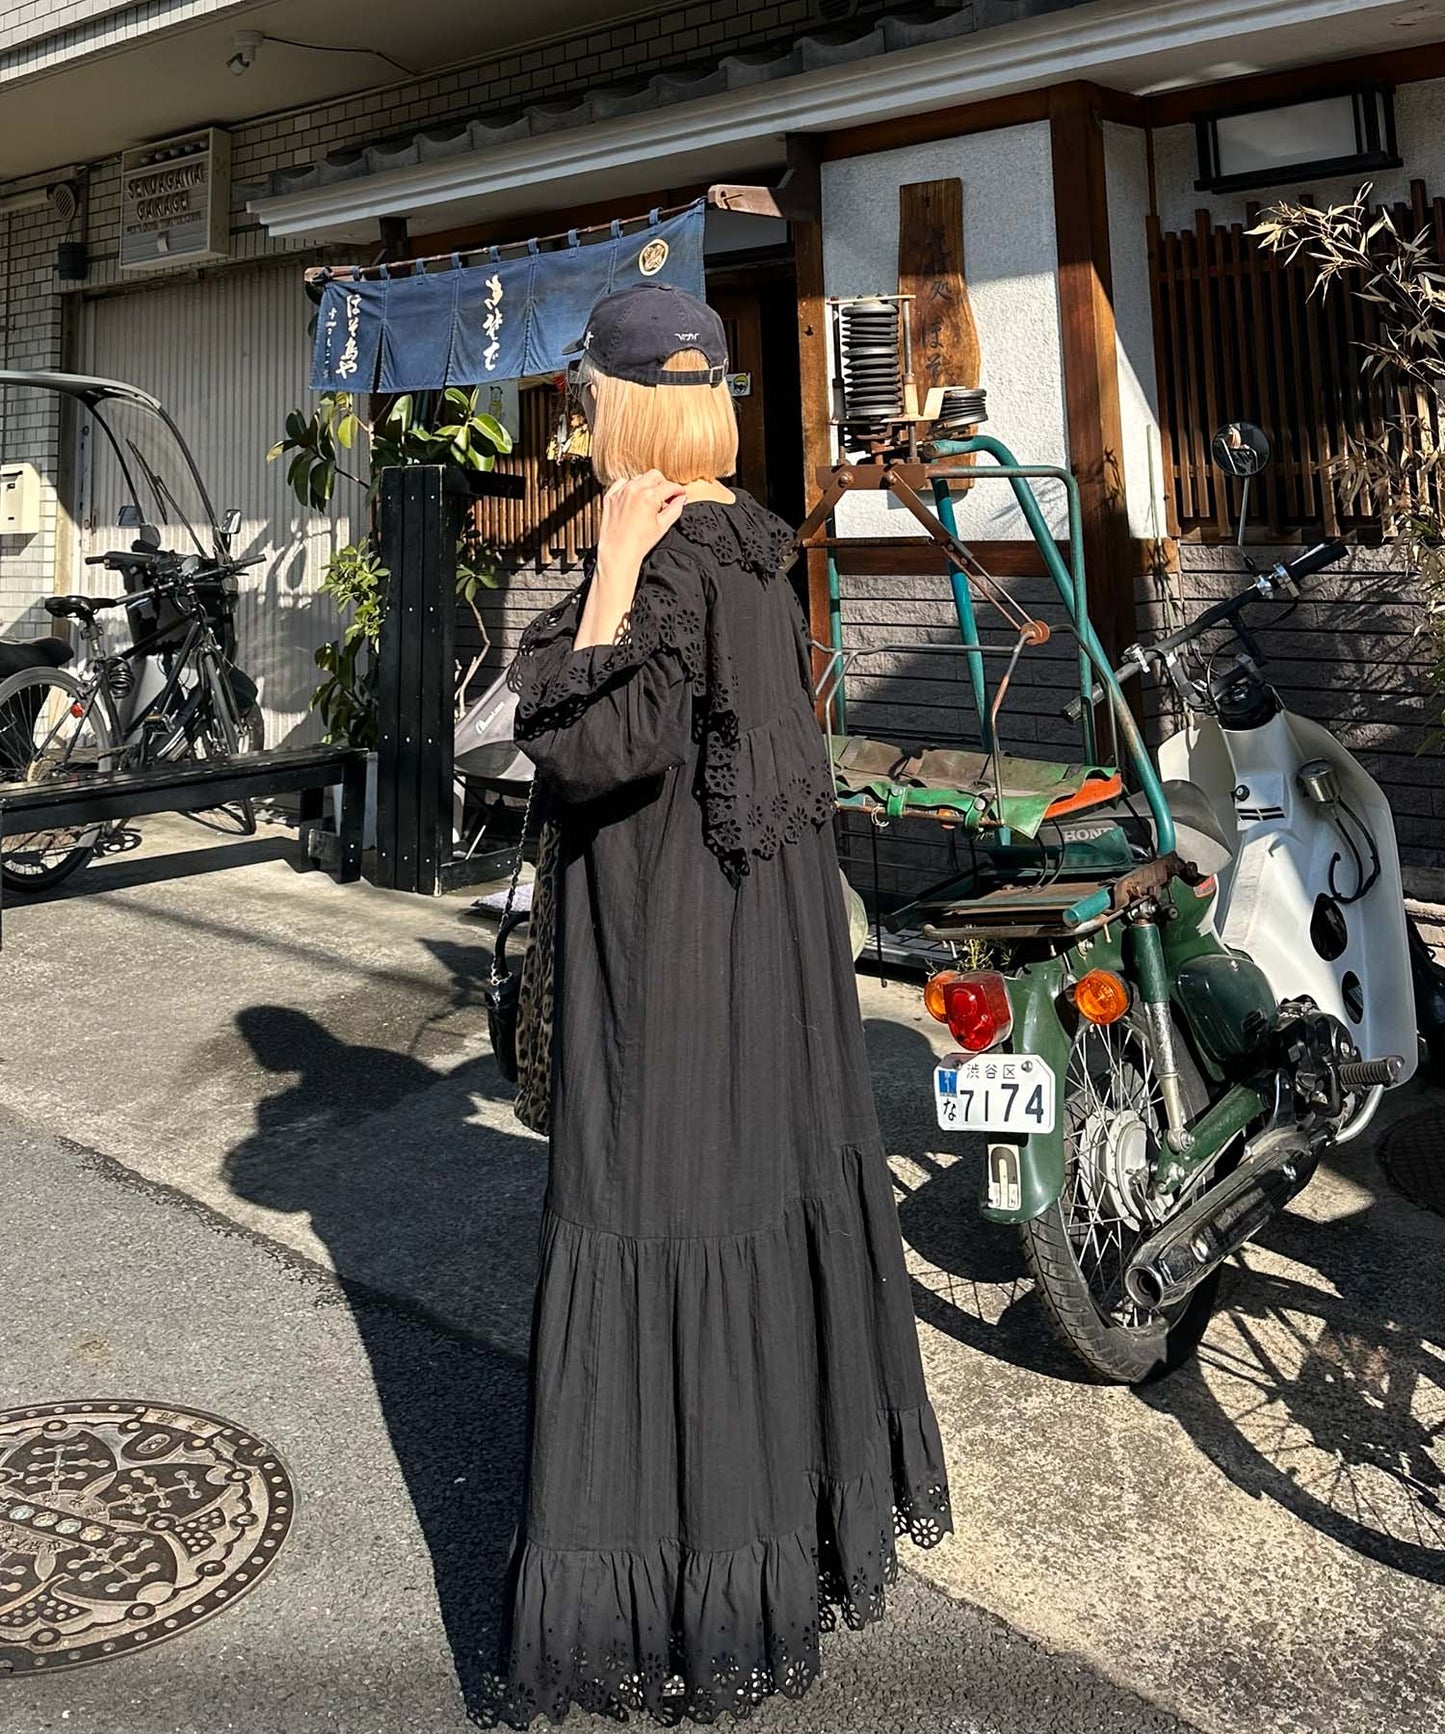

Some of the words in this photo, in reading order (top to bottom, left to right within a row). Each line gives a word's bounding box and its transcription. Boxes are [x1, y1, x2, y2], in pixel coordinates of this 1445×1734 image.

[1062, 827, 1115, 842] HON
[966, 1063, 1016, 1079] 渋谷区
[942, 1099, 957, 1122] な
[959, 1083, 1044, 1124] 7174
